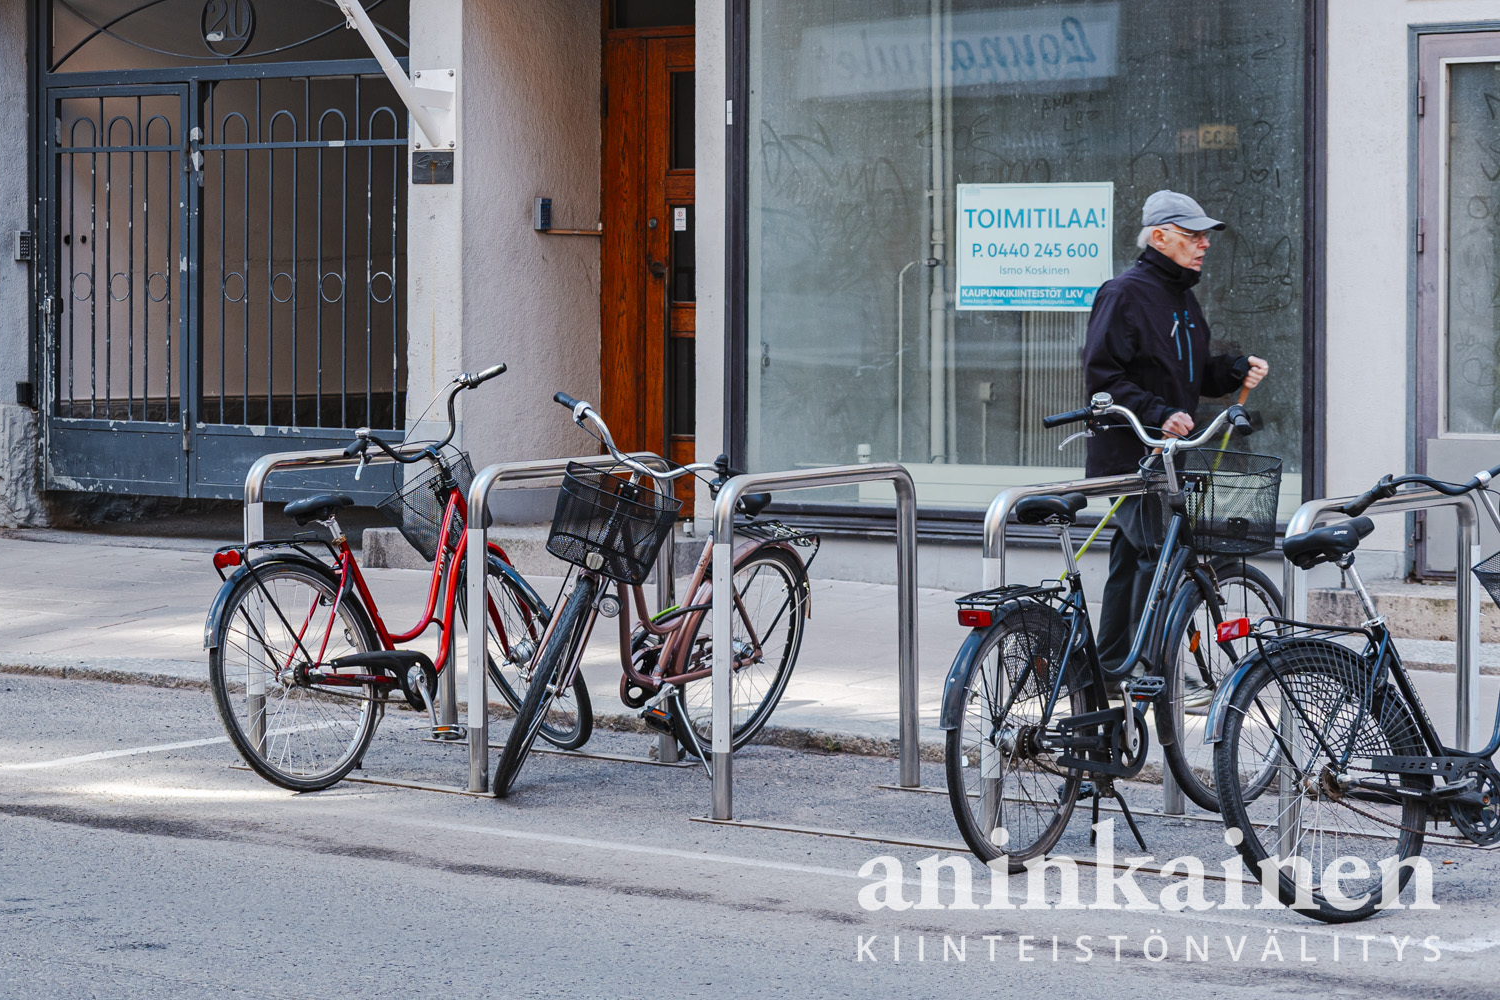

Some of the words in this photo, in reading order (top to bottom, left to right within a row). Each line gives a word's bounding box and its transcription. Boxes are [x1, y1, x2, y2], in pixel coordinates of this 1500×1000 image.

[963, 207, 1106, 229] TOIMITILAA!
[972, 243, 983, 258] P.
[987, 243, 1030, 258] 0440
[1034, 243, 1062, 258] 245
[1067, 243, 1099, 258] 600
[999, 265, 1023, 275] Ismo
[1025, 265, 1070, 275] Koskinen
[961, 287, 1062, 298] KAUPUNKIKIINTEISTÖT
[1065, 289, 1084, 298] LKV
